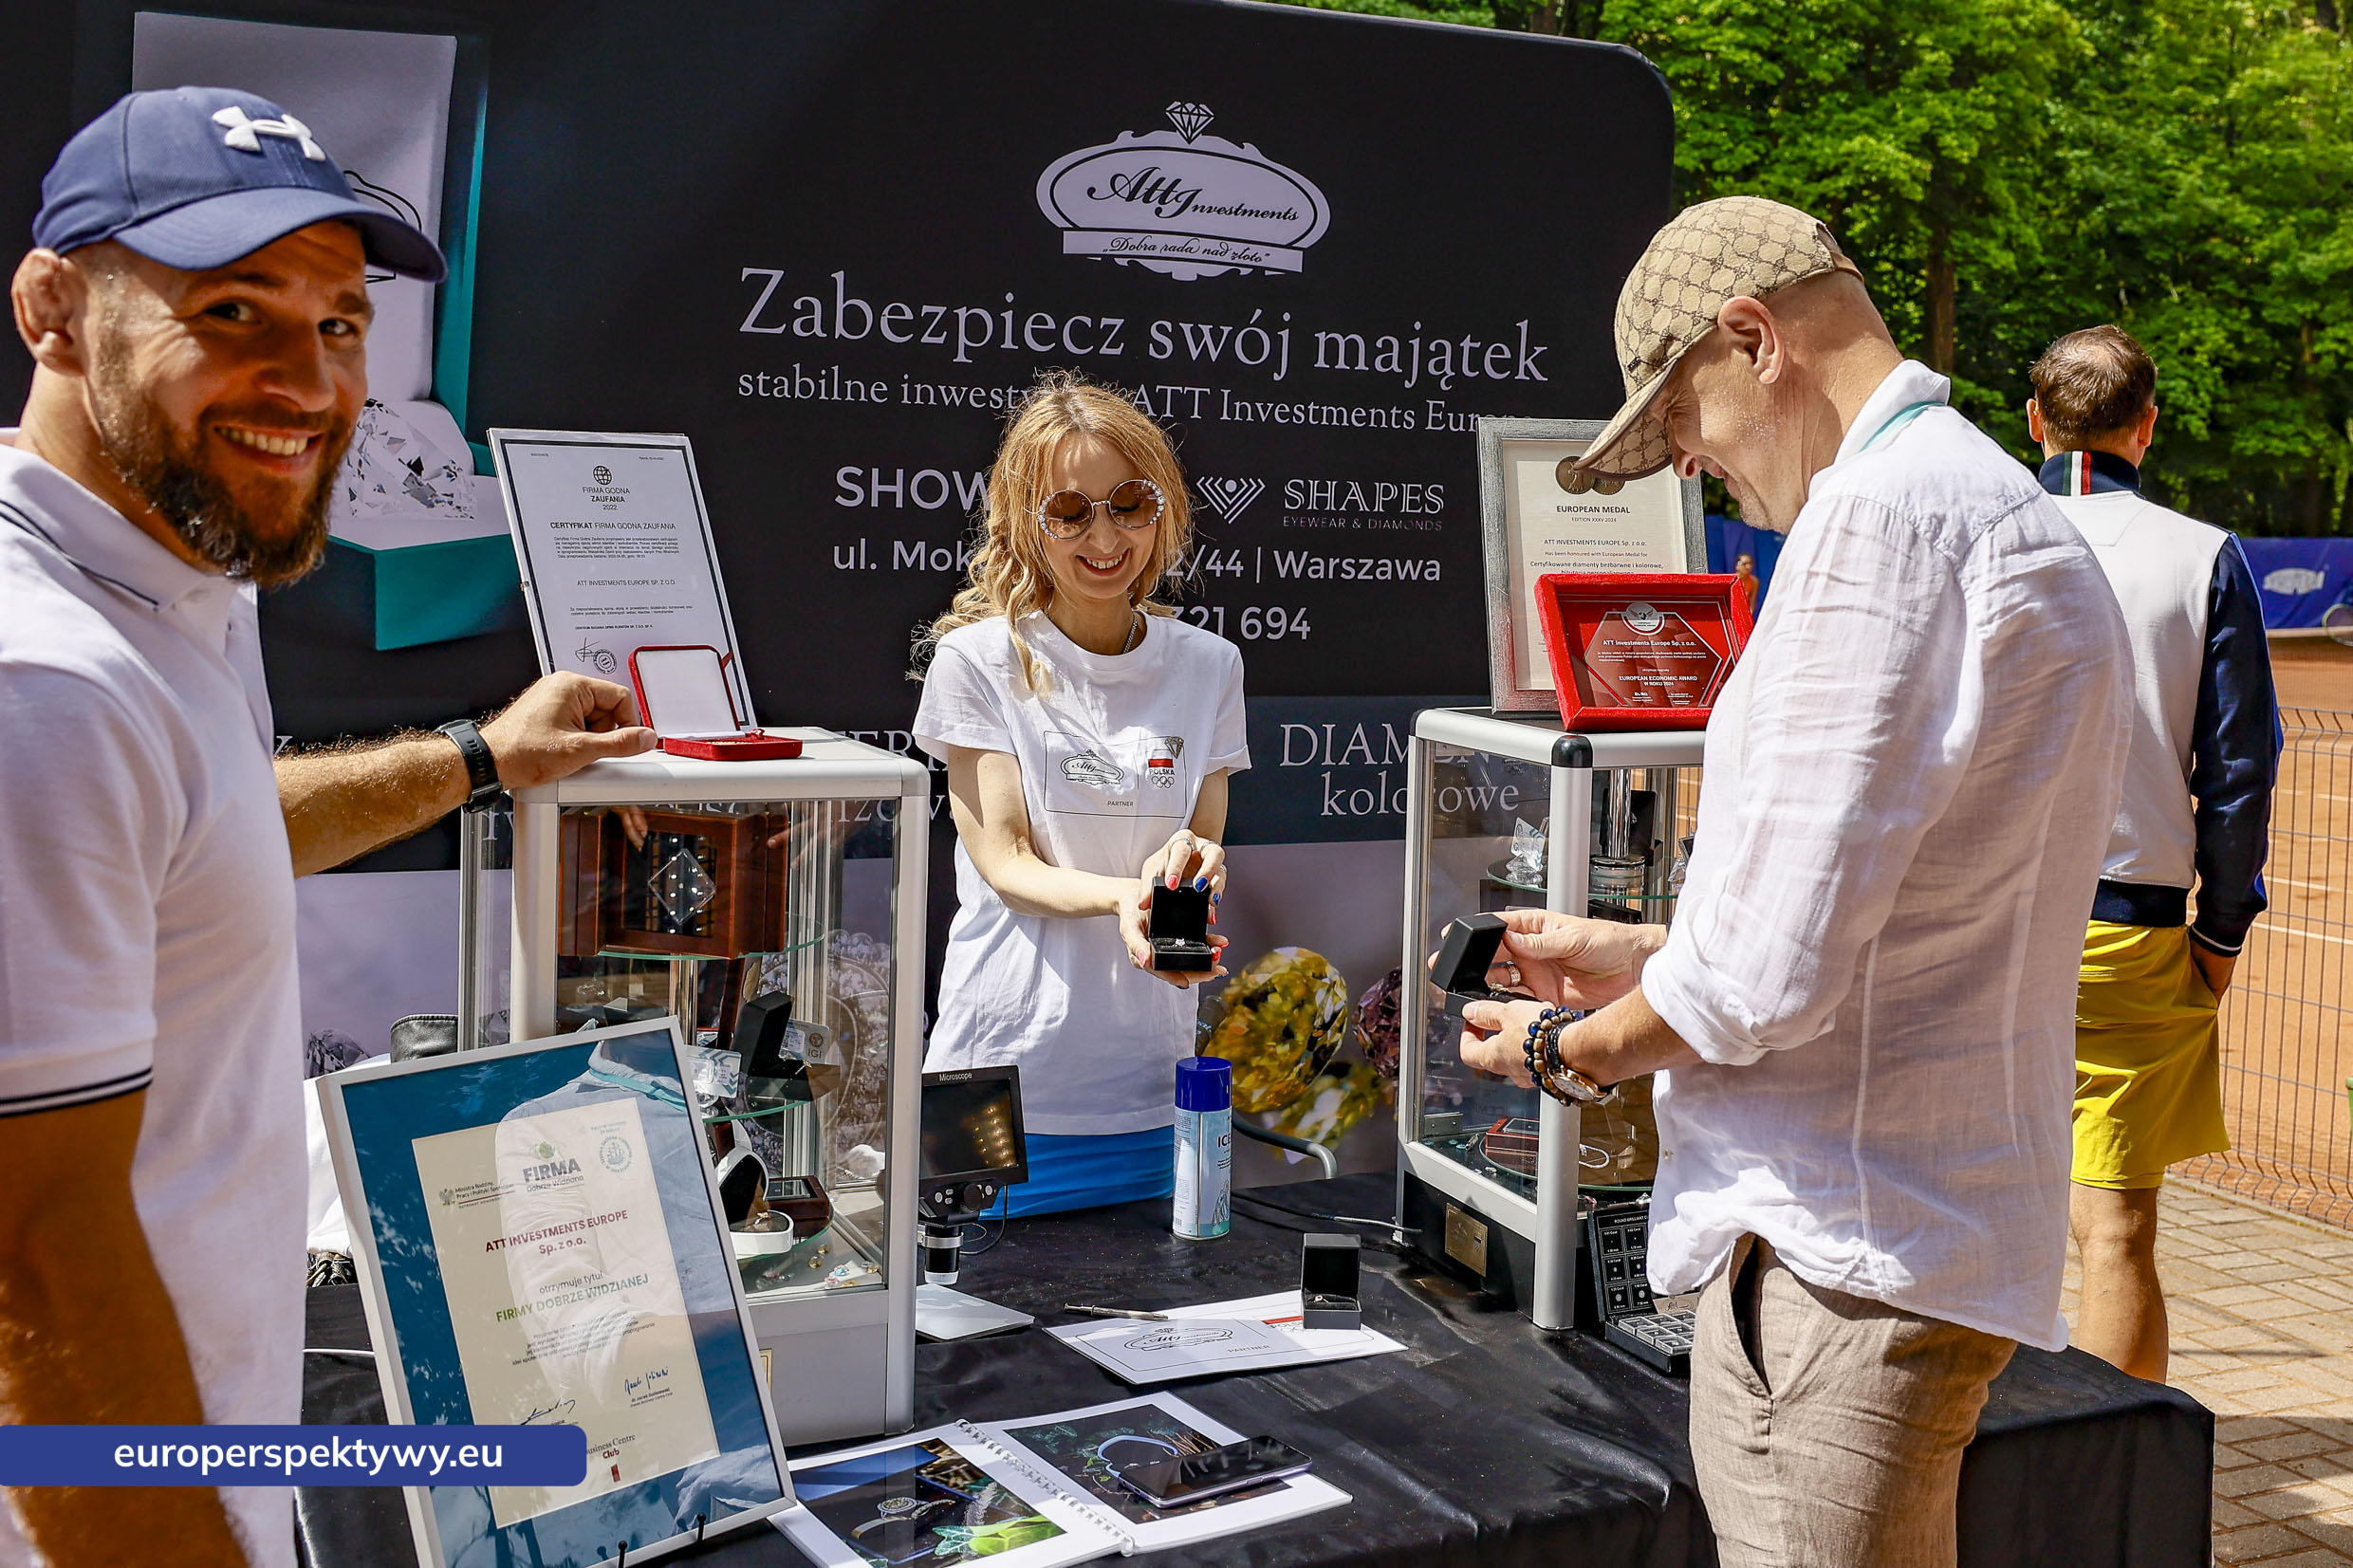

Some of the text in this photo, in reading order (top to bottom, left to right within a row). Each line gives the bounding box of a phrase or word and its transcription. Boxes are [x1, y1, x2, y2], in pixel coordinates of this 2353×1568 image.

[1160, 238, 1201, 253] rada
[1202, 242, 1232, 257] nad
[739, 267, 1548, 391] Zabezpiecz swój majątek
[738, 362, 888, 403] stabilne
[1134, 384, 1211, 419] ATT
[1220, 389, 1416, 430] Investments
[1425, 400, 1499, 433] Eur
[835, 466, 991, 511] SHOW
[1284, 479, 1444, 514] SHAPES
[1283, 516, 1442, 531] EYEWEAR & DIAMONDS
[1602, 506, 1631, 514] MEDAL
[833, 538, 877, 570] ul.
[1273, 550, 1441, 581] Warszawa
[1240, 607, 1311, 640] 694
[808, 1048, 822, 1059] IGI
[939, 1072, 973, 1081] Microscope
[523, 1157, 582, 1184] FIRMA
[486, 1209, 628, 1253] ATT INVESTMENTS EUROPE
[495, 1273, 649, 1323] FIRMY DOBRZE WIDZIANEJ
[539, 1275, 584, 1296] otrzymuje
[1228, 1345, 1270, 1353] PARTNER
[585, 1442, 613, 1455] usiness
[602, 1448, 620, 1459] Club
